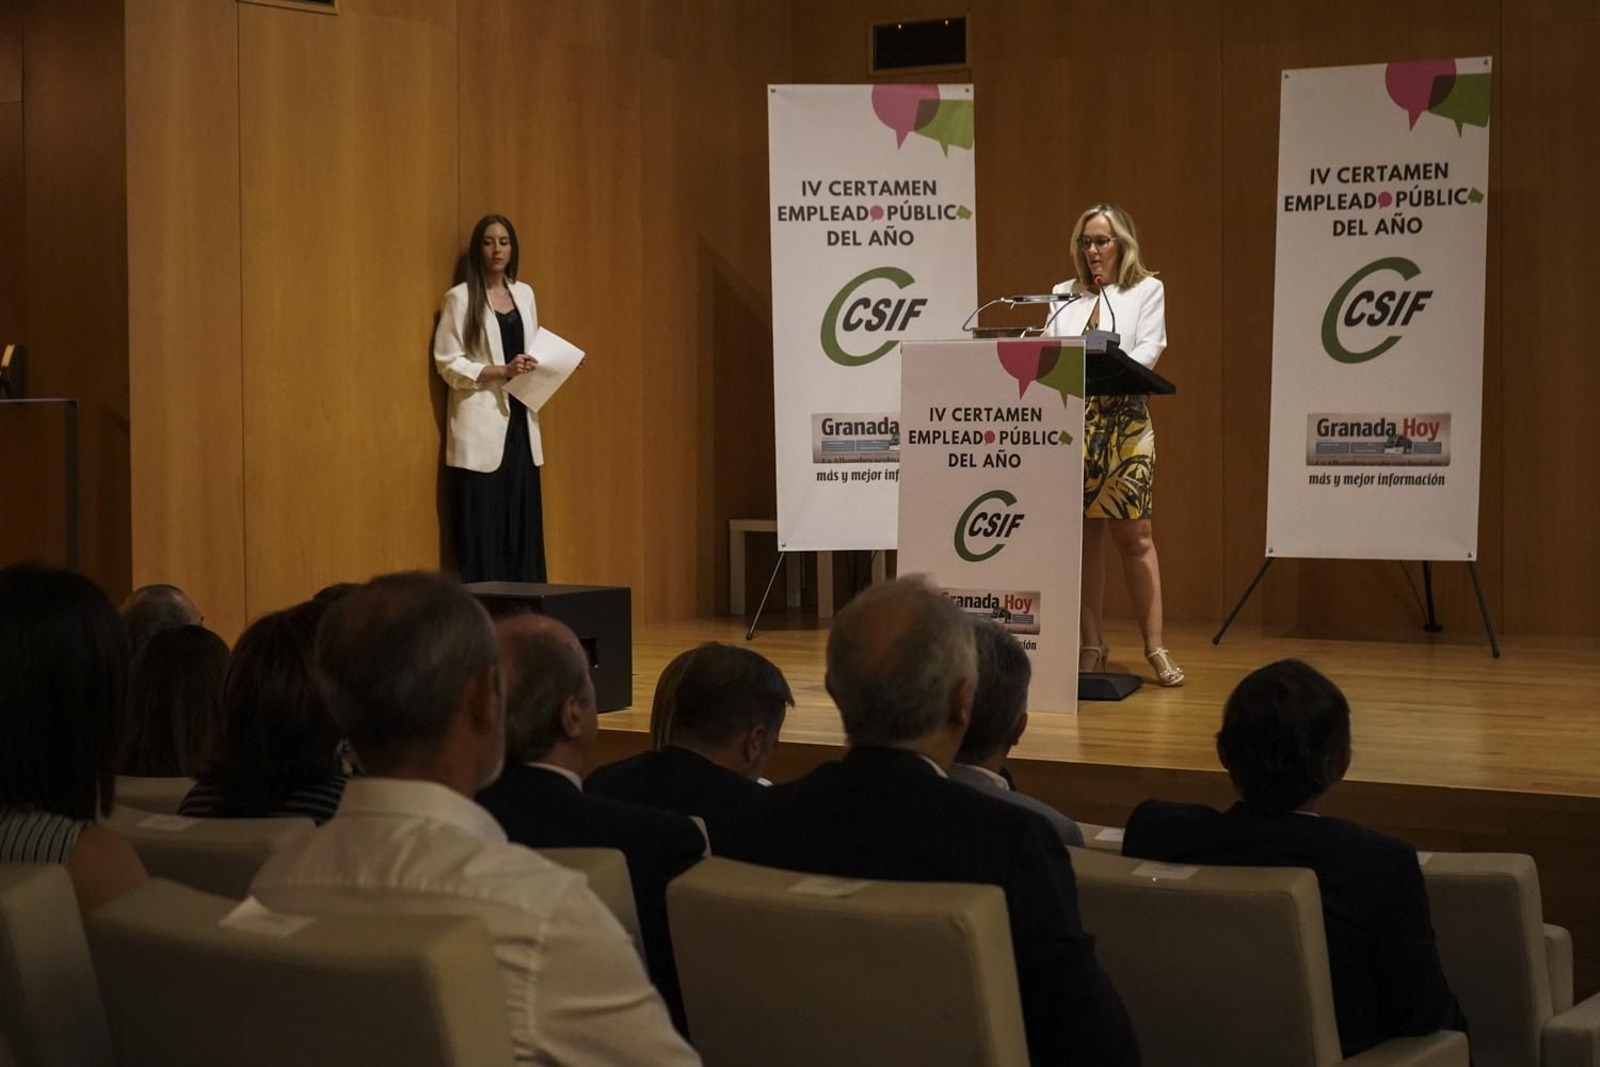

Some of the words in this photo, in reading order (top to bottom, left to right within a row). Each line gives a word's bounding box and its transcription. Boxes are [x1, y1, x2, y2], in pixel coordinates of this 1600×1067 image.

[1309, 167, 1331, 185] IV
[1336, 162, 1449, 184] CERTAMEN
[801, 180, 822, 196] IV
[828, 180, 937, 196] CERTAMEN
[1332, 219, 1368, 236] DEL
[1374, 213, 1423, 235] AÑO
[827, 230, 862, 246] DEL
[868, 225, 914, 246] AÑO
[842, 297, 928, 332] CSIF
[1344, 290, 1434, 327] CSIF
[929, 407, 946, 422] IV
[952, 407, 1042, 422] CERTAMEN
[821, 417, 900, 435] Granada
[1316, 418, 1396, 437] Granada
[1403, 418, 1440, 441] Hoy
[948, 453, 977, 467] DEL
[983, 449, 1021, 468] AÑO
[816, 469, 839, 481] más
[841, 471, 848, 483] y
[851, 469, 882, 483] mejor
[1309, 472, 1331, 485] más
[1333, 474, 1341, 487] y
[1343, 472, 1376, 487] mejor
[1378, 472, 1445, 487] información
[968, 512, 1025, 538] CSIF
[1004, 594, 1033, 614] Hoy
